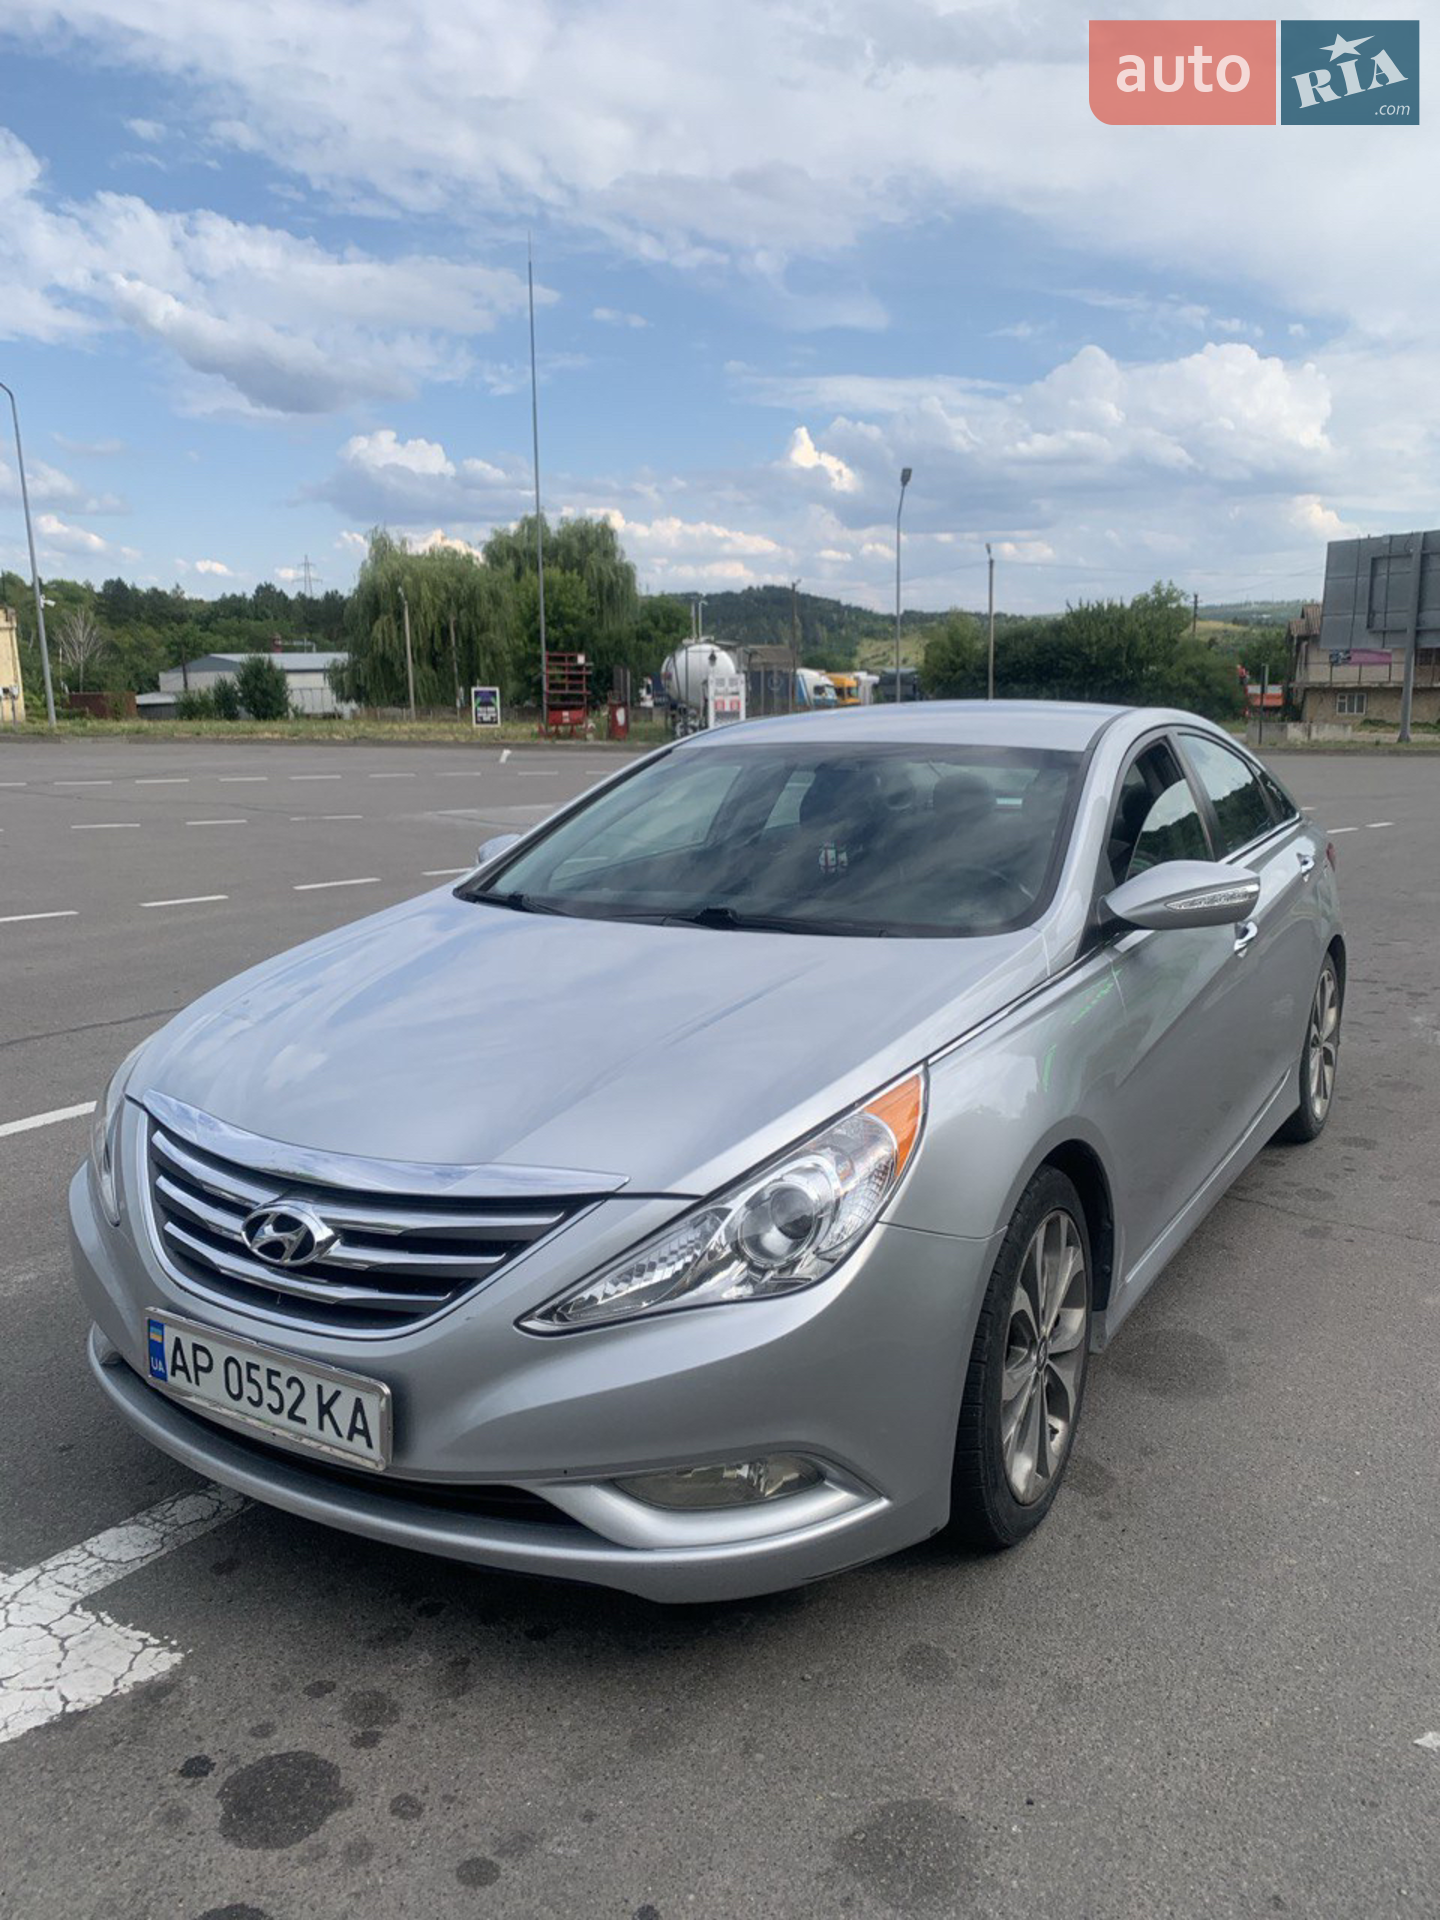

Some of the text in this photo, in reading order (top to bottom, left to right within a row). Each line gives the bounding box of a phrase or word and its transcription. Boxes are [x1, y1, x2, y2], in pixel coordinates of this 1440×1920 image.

[150, 1357, 165, 1373] UA
[170, 1336, 374, 1450] AP 0552 KA
